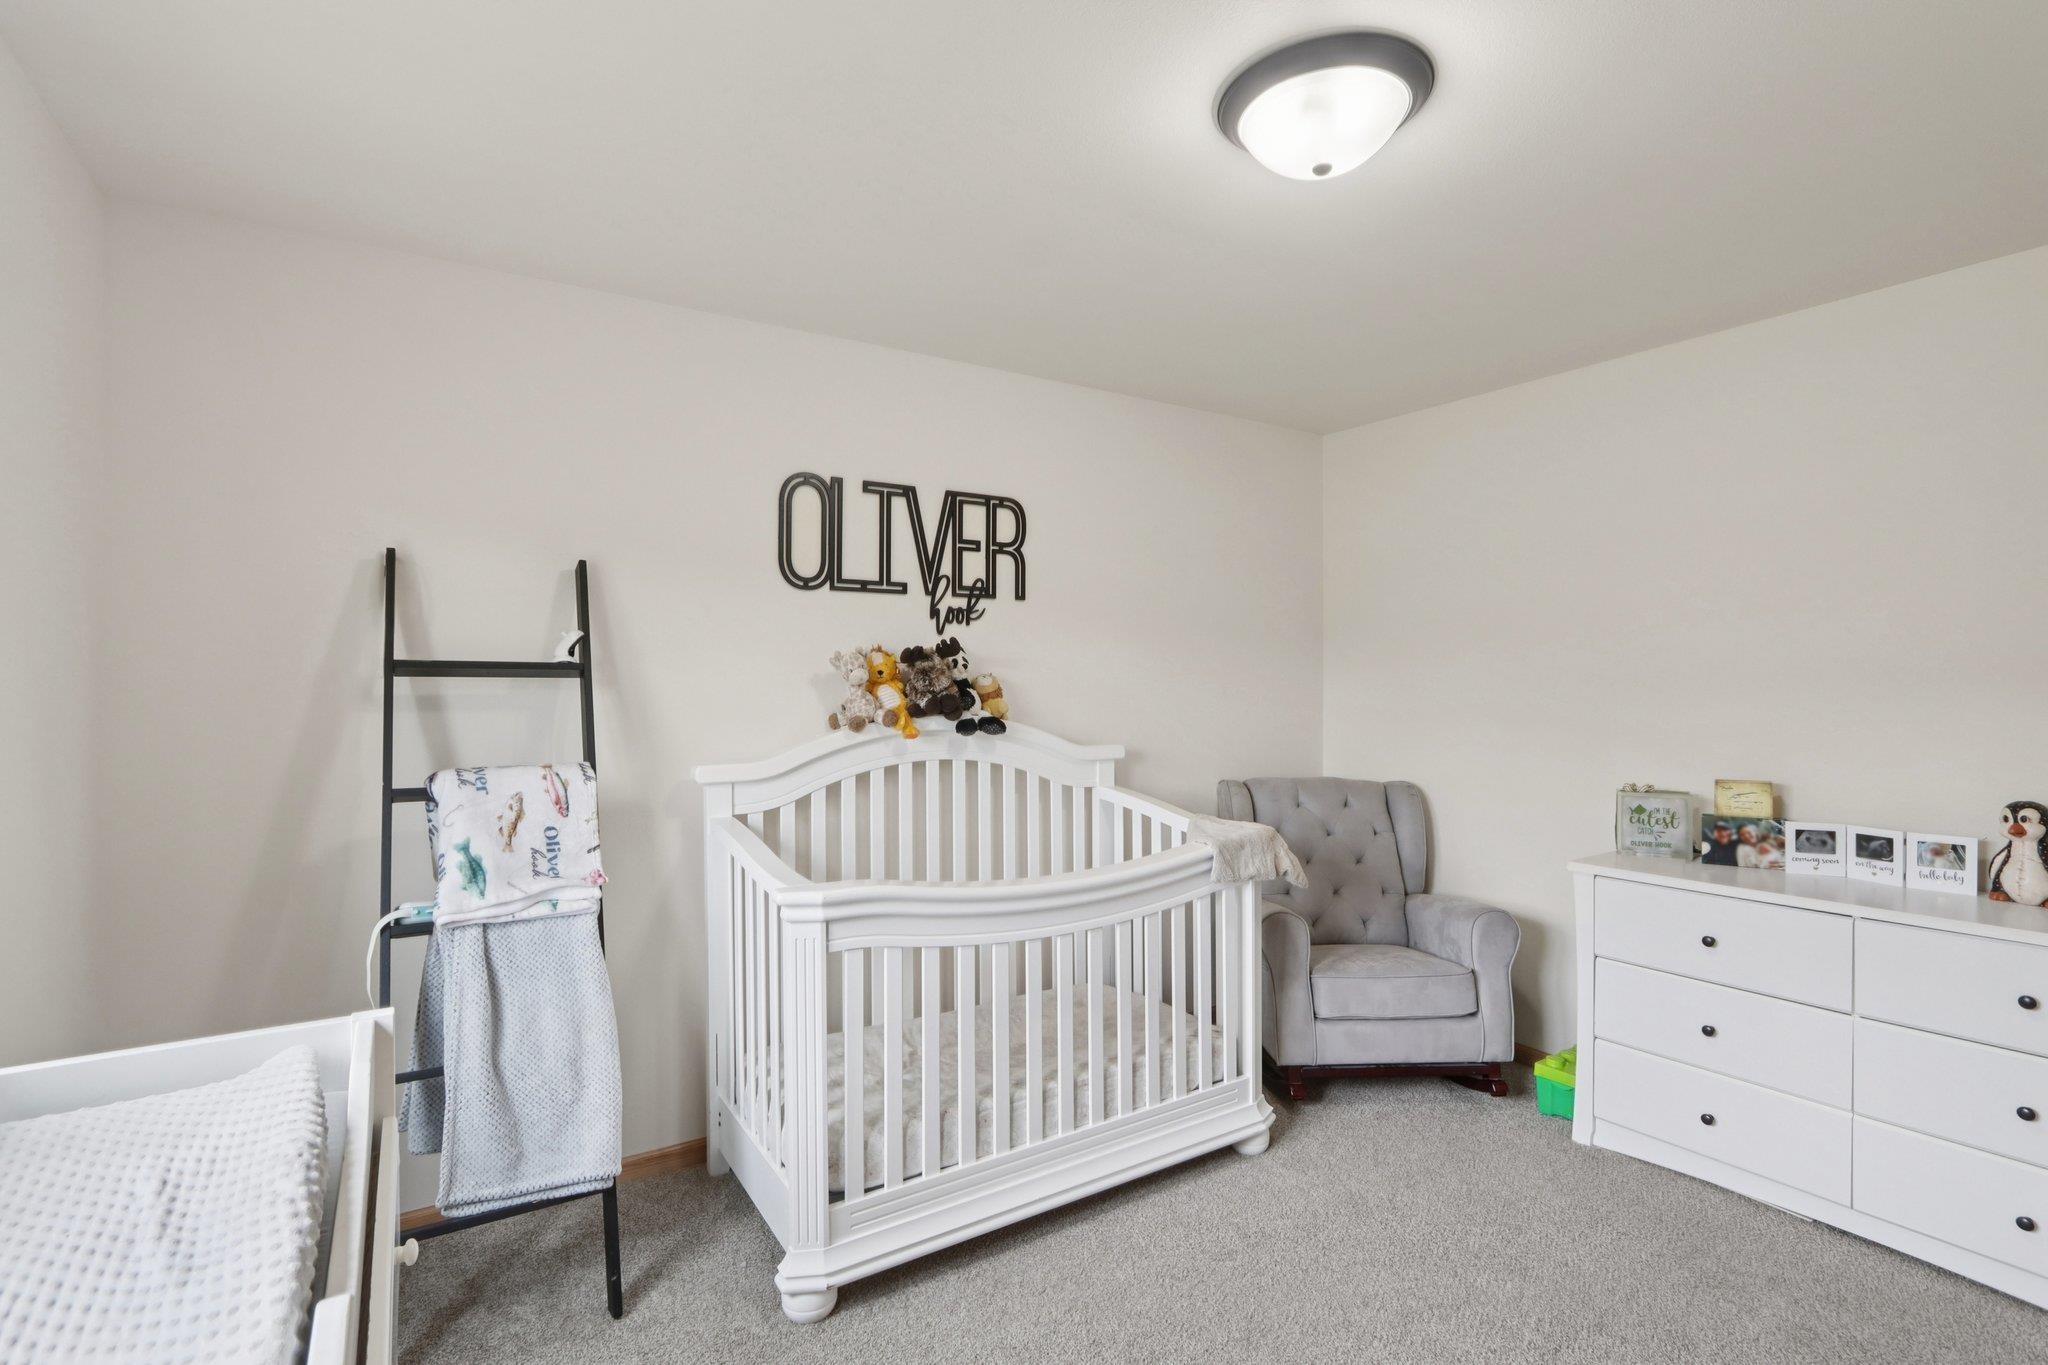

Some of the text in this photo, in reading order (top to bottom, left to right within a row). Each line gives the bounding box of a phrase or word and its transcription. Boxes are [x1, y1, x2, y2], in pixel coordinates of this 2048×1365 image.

[778, 472, 1027, 601] OLIVER
[930, 574, 986, 635] hook
[1629, 810, 1680, 830] cutest
[530, 846, 549, 880] hook
[543, 825, 562, 879] Olive
[1792, 856, 1820, 866] coming
[1878, 866, 1894, 876] way
[1918, 869, 1964, 885] hello baby
